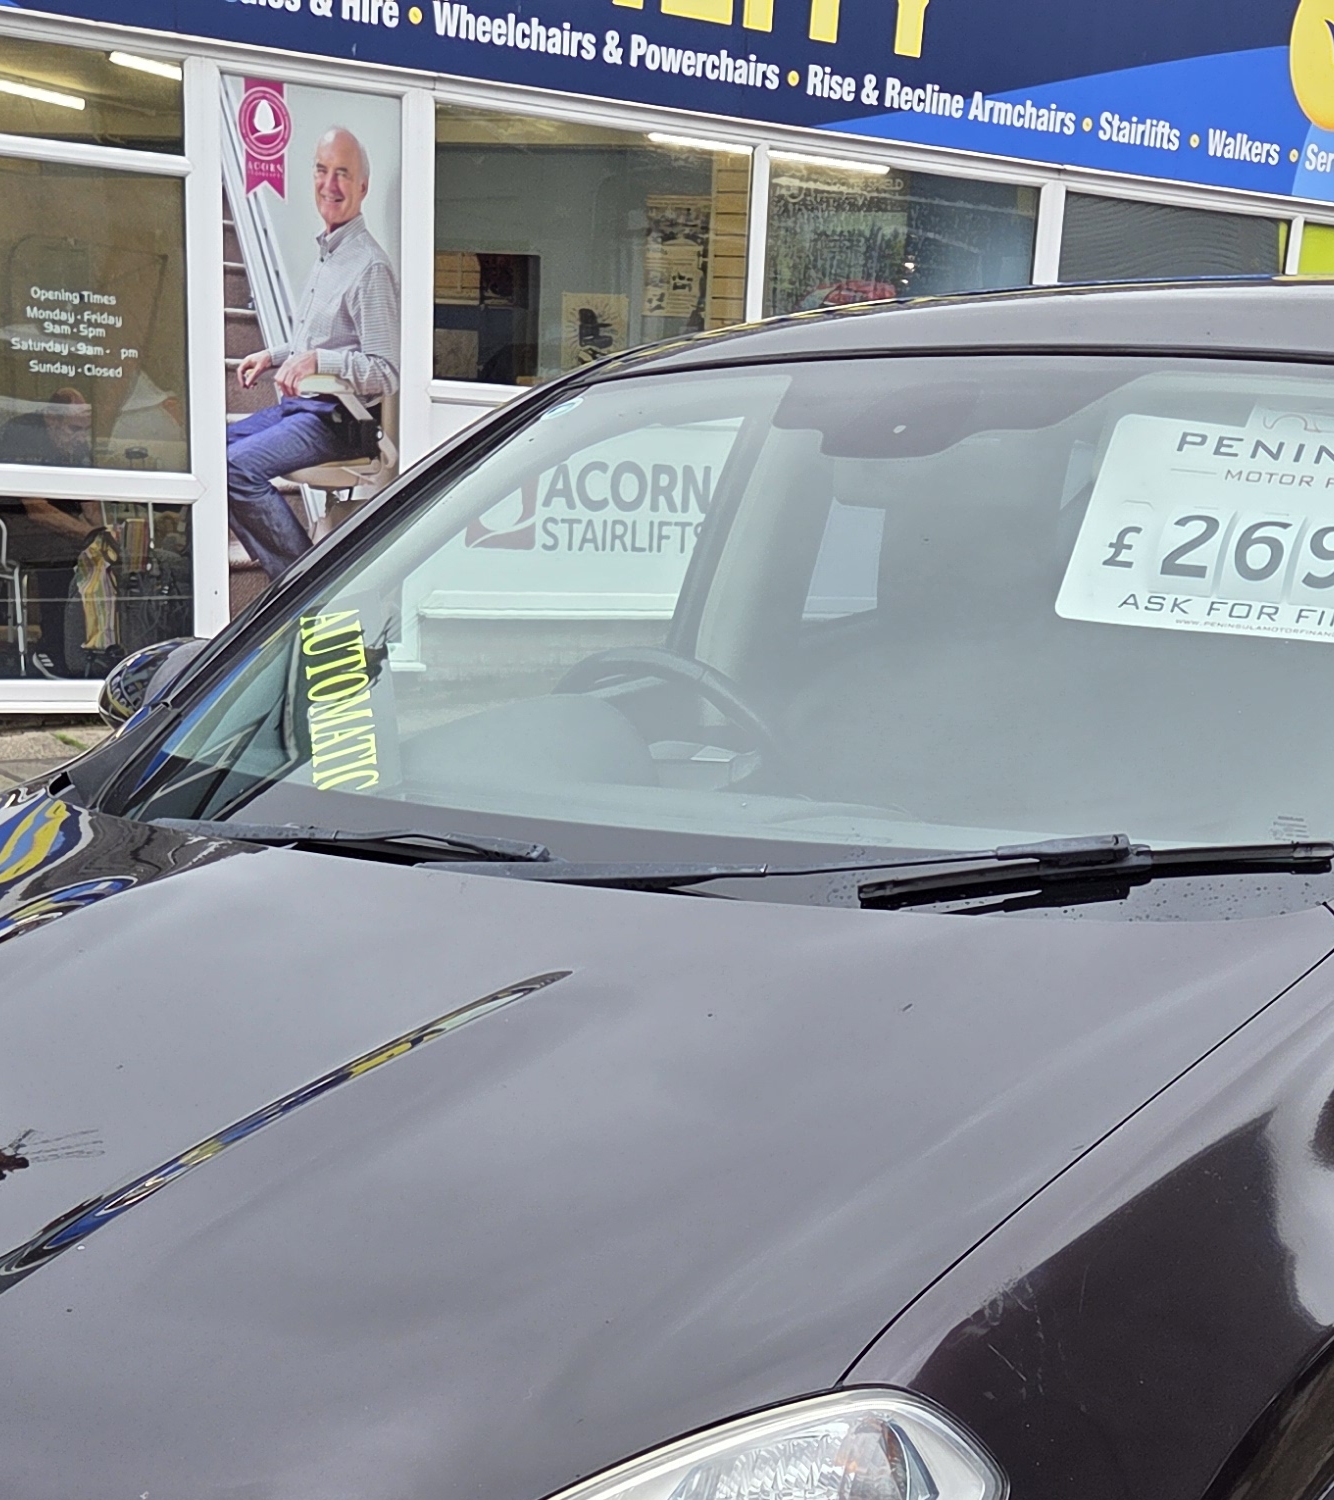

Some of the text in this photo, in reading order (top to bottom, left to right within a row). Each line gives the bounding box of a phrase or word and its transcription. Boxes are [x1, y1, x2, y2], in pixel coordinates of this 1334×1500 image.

[341, 0, 400, 28] Hire
[432, 0, 597, 61] Wheelchairs
[602, 30, 624, 65] &
[630, 34, 781, 90] Powerchairs
[806, 64, 857, 102] Rise
[861, 73, 879, 106] &
[884, 77, 965, 118] Recline
[967, 91, 1077, 136] Armchairs
[1098, 111, 1181, 151] Stairlifts
[1207, 128, 1281, 166] Walkers
[30, 286, 117, 305] Opening Times
[26, 306, 123, 328] Monday Friday
[43, 321, 106, 339] 9am 5pm
[10, 337, 139, 360] Saturday 9am pm
[29, 360, 123, 378] Sunday Closed
[541, 460, 713, 515] ACORN
[1224, 468, 1315, 488] MOTOR
[1117, 593, 1194, 616] ASK
[1206, 601, 1281, 623] FOR
[299, 609, 380, 791] AUTOMATIC
